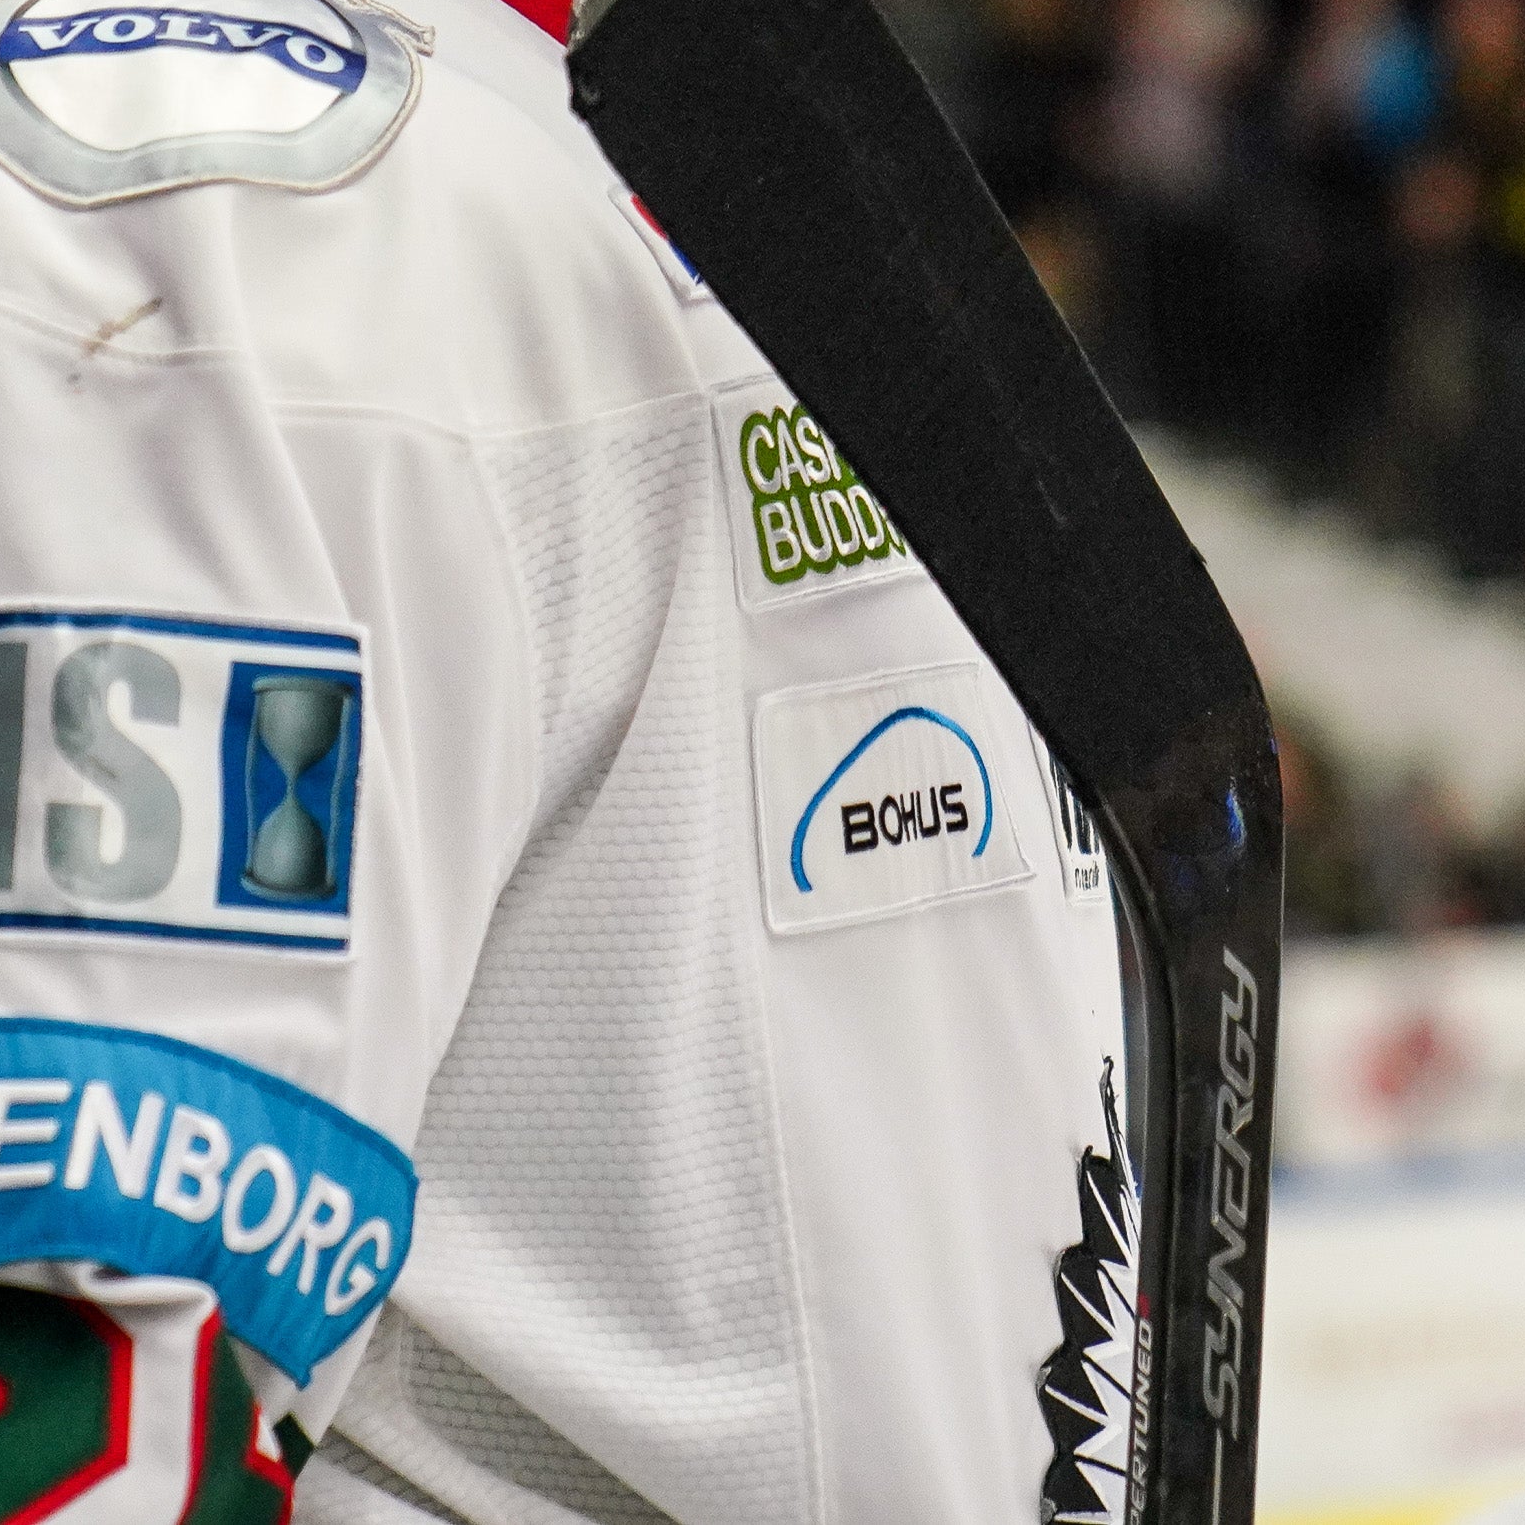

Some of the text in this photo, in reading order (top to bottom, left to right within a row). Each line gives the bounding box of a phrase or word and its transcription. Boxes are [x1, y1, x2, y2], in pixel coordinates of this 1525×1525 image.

[18, 12, 347, 73] VOLVO
[760, 484, 902, 573] BUDD
[841, 783, 969, 855] BOHUS
[1202, 946, 1259, 1442] SYNERGY
